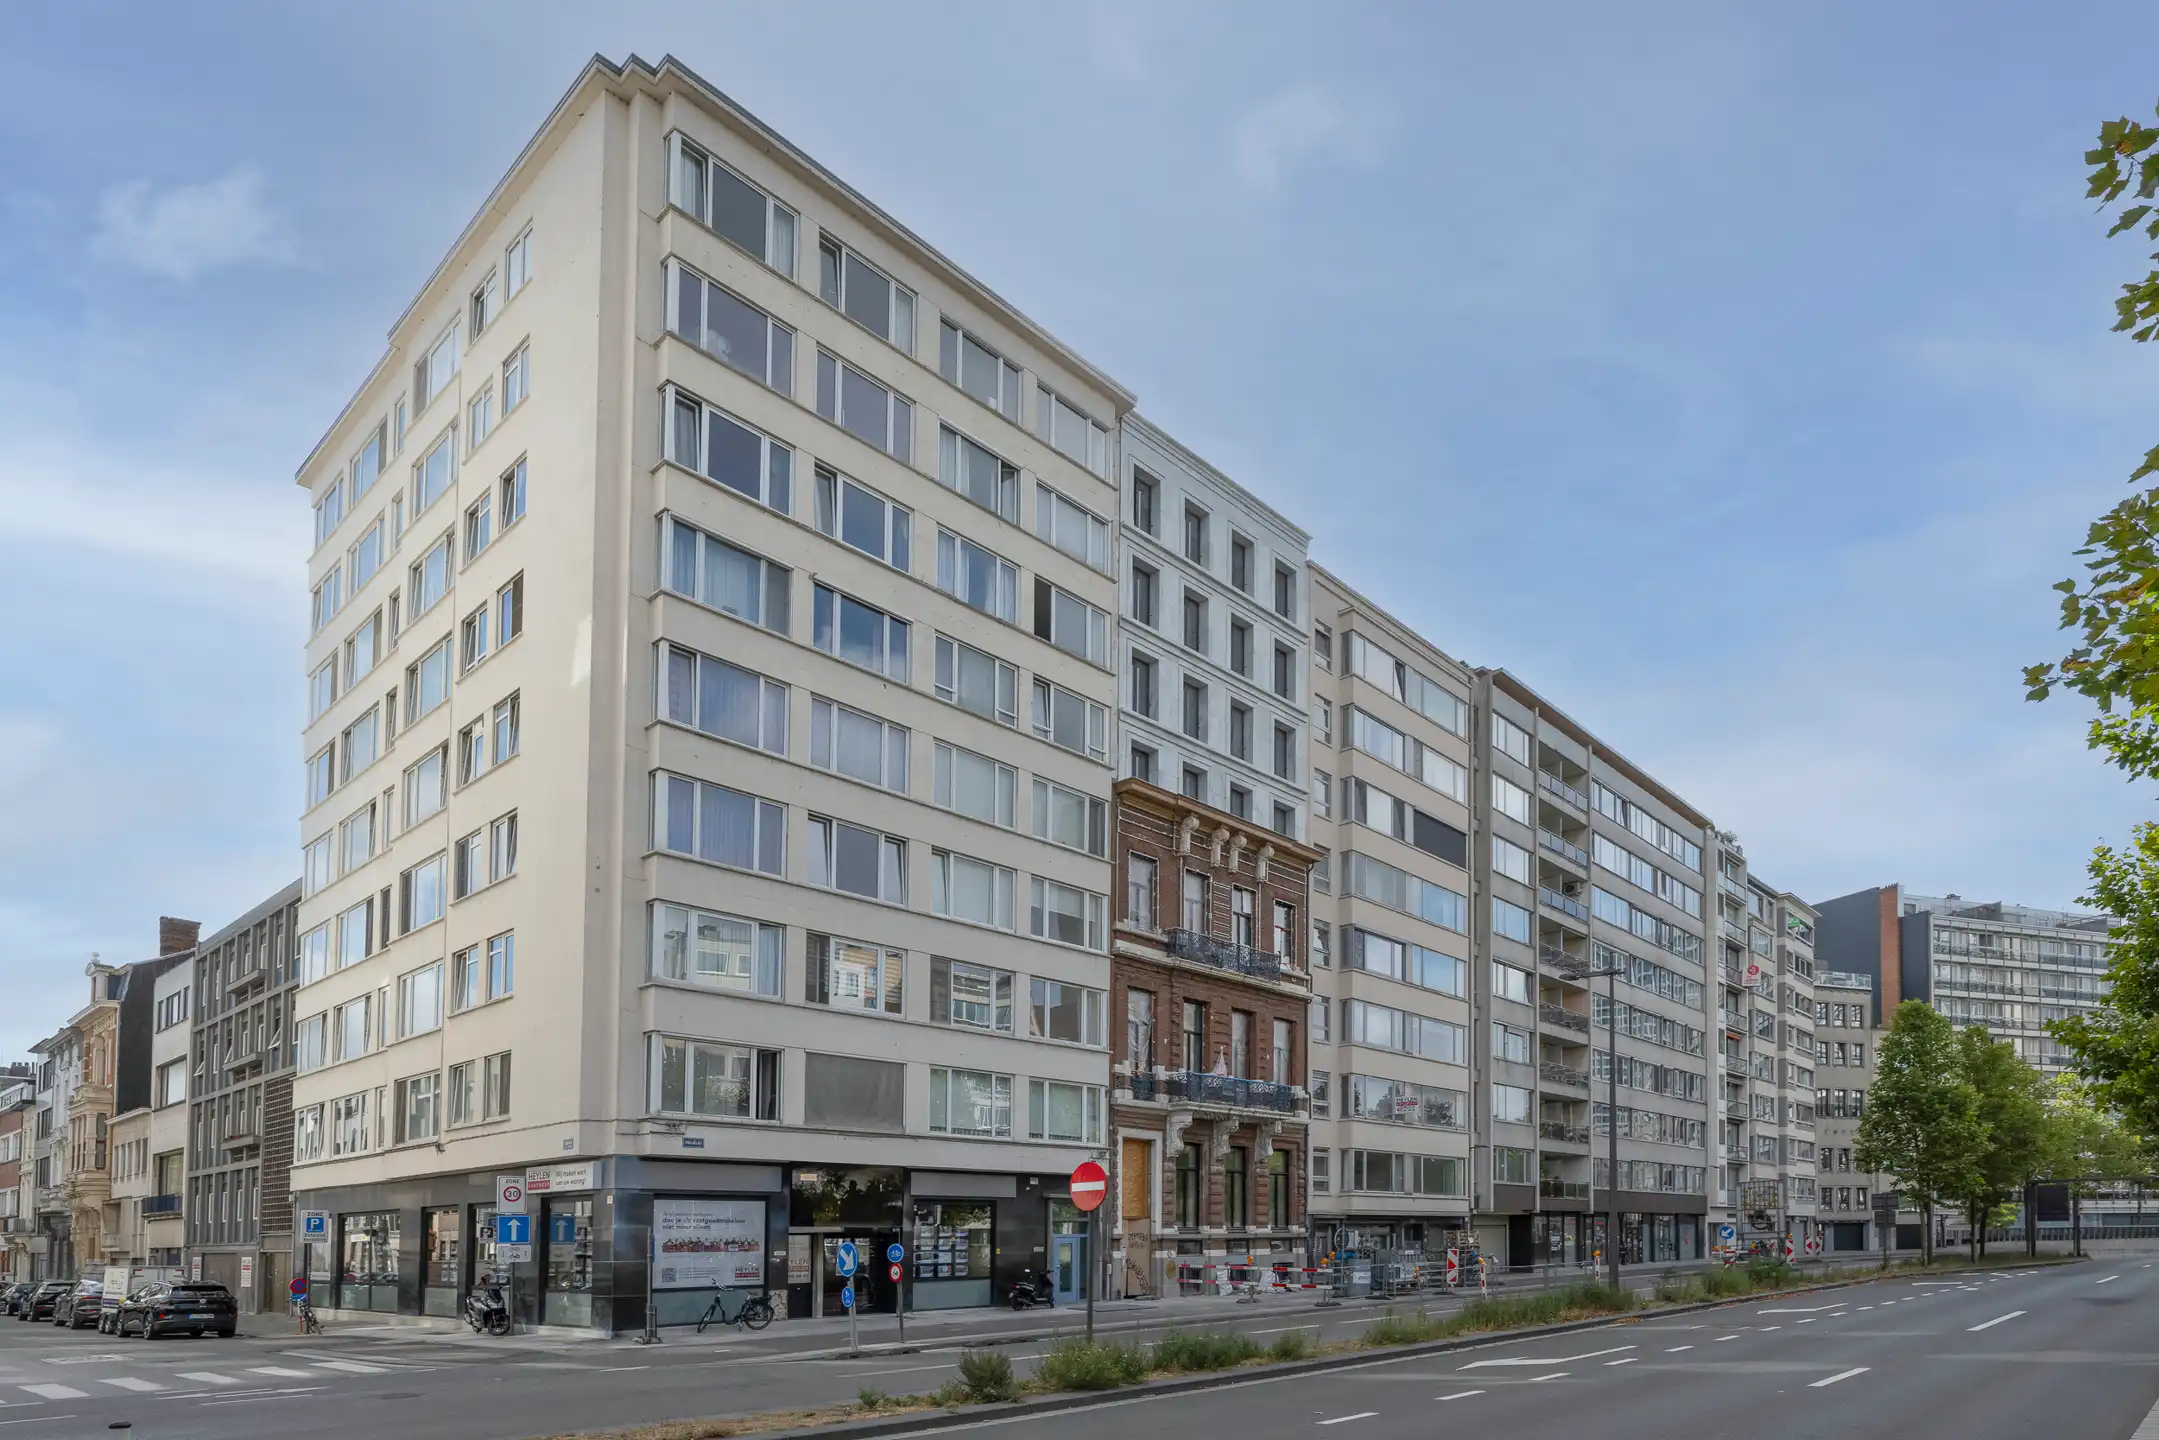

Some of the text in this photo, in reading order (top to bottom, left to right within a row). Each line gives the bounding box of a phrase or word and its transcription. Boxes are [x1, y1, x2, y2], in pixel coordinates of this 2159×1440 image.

[528, 1171, 550, 1180] HEYLEN
[507, 1190, 519, 1198] 30
[310, 1218, 320, 1229] P
